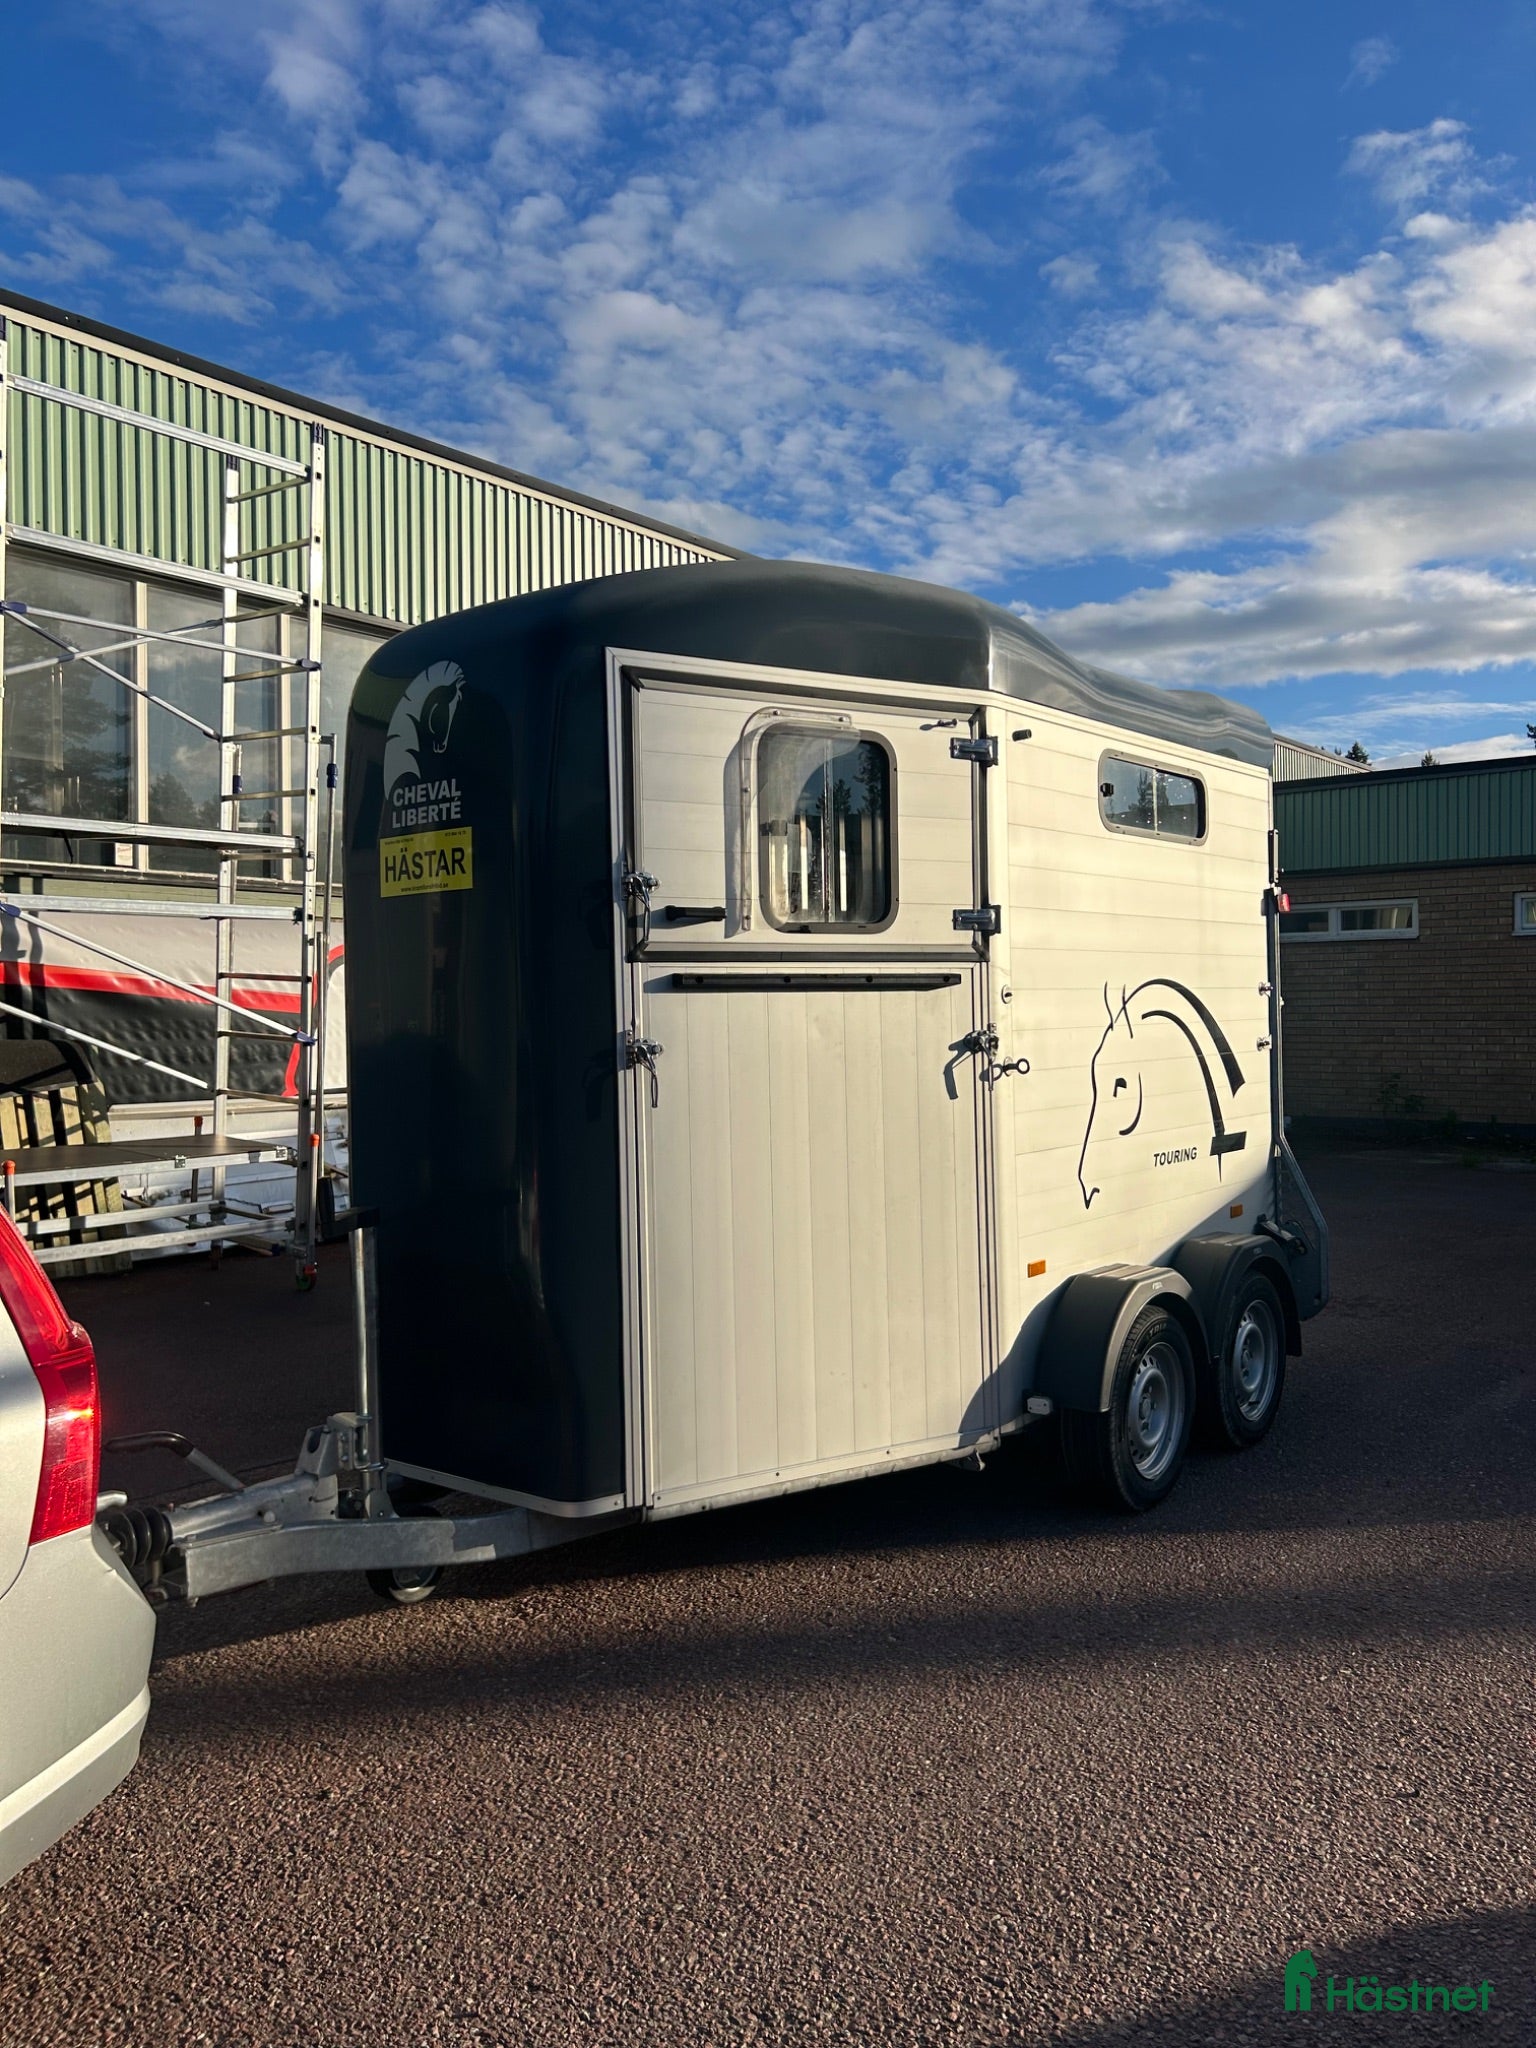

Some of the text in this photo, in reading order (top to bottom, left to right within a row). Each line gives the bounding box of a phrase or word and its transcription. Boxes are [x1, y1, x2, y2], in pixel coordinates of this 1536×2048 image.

[393, 778, 462, 807] CHEVAL
[392, 797, 462, 829] LIBERTÉ
[384, 847, 467, 884] HÄSTAR
[1153, 1147, 1198, 1168] TOURING
